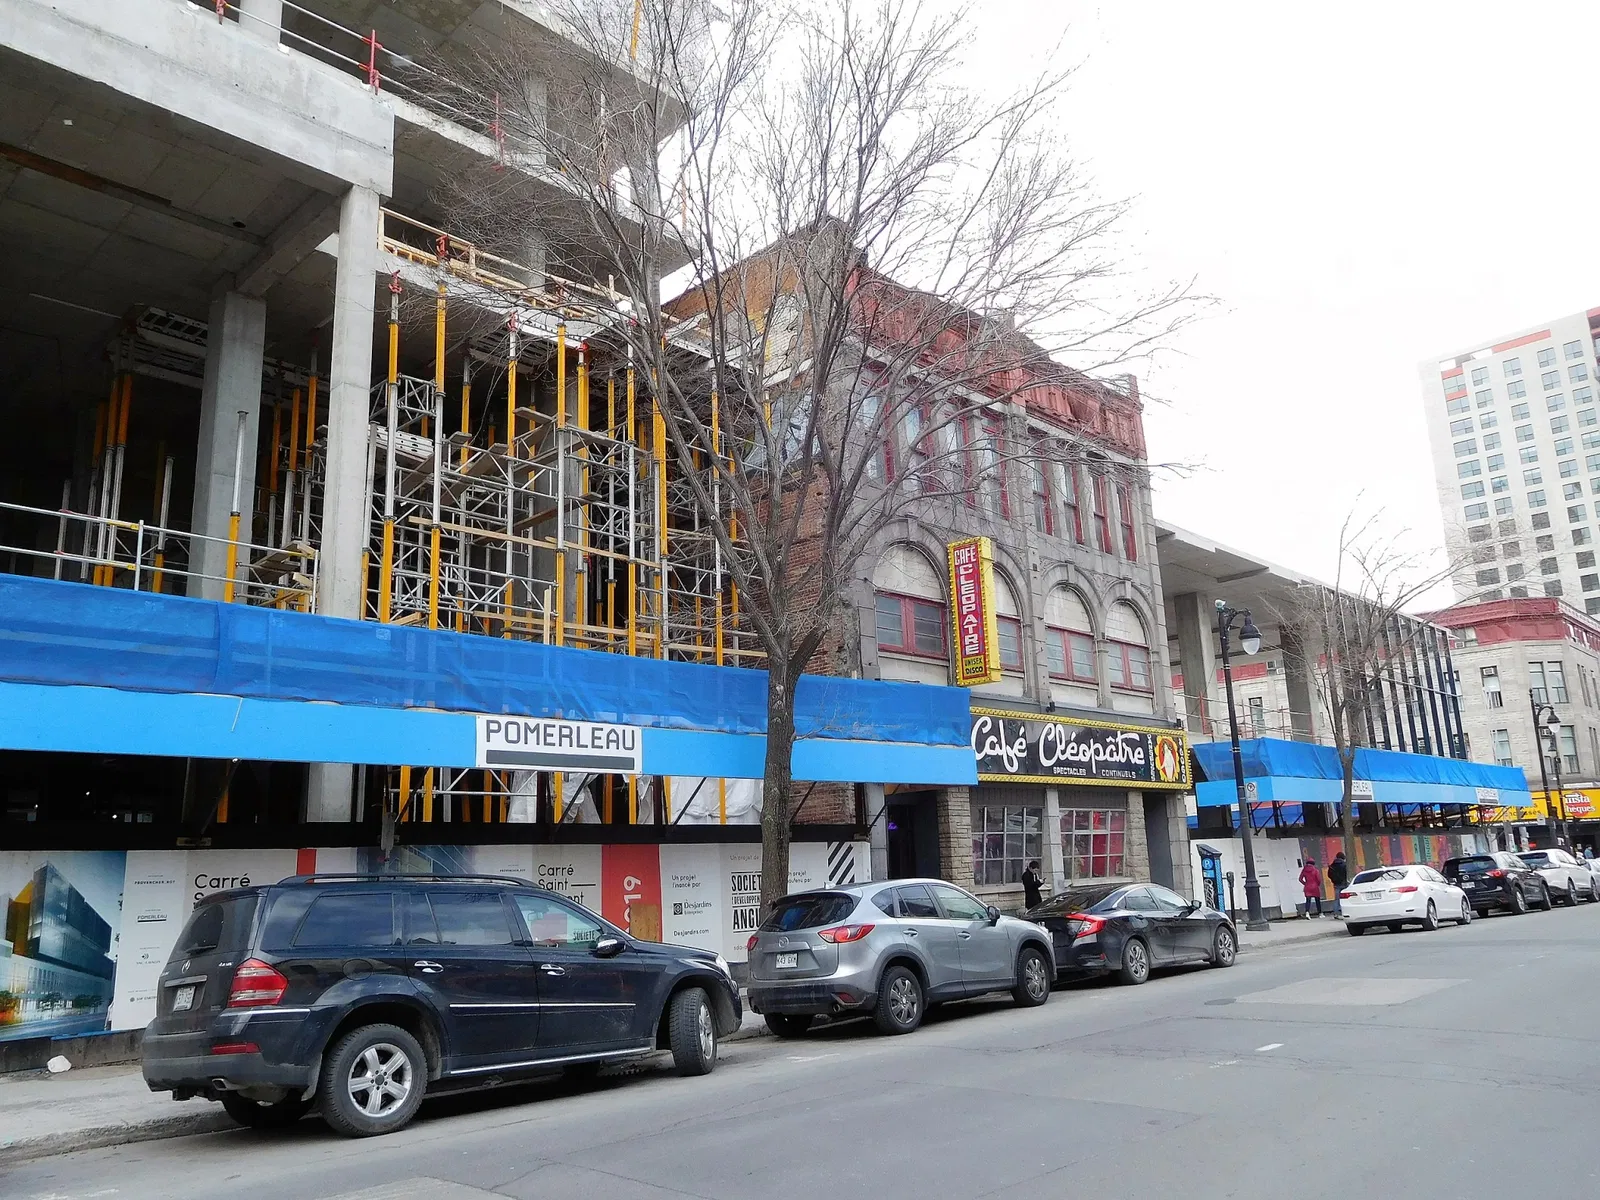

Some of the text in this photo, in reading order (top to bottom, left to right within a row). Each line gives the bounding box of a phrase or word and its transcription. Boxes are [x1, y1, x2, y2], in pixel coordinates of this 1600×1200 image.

[964, 658, 983, 667] UNISEX
[965, 665, 983, 675] DISCO
[486, 719, 635, 751] POMERLEAU
[971, 716, 1145, 774] Café Cléopâtre
[1053, 766, 1137, 779] SPECTACLES CONTINUELS
[538, 864, 574, 877] Carré
[194, 872, 251, 889] Carré
[679, 874, 697, 882] projet
[683, 900, 712, 910] Desjardins
[733, 908, 761, 930] ANGU
[673, 928, 710, 937] Desjardins.com
